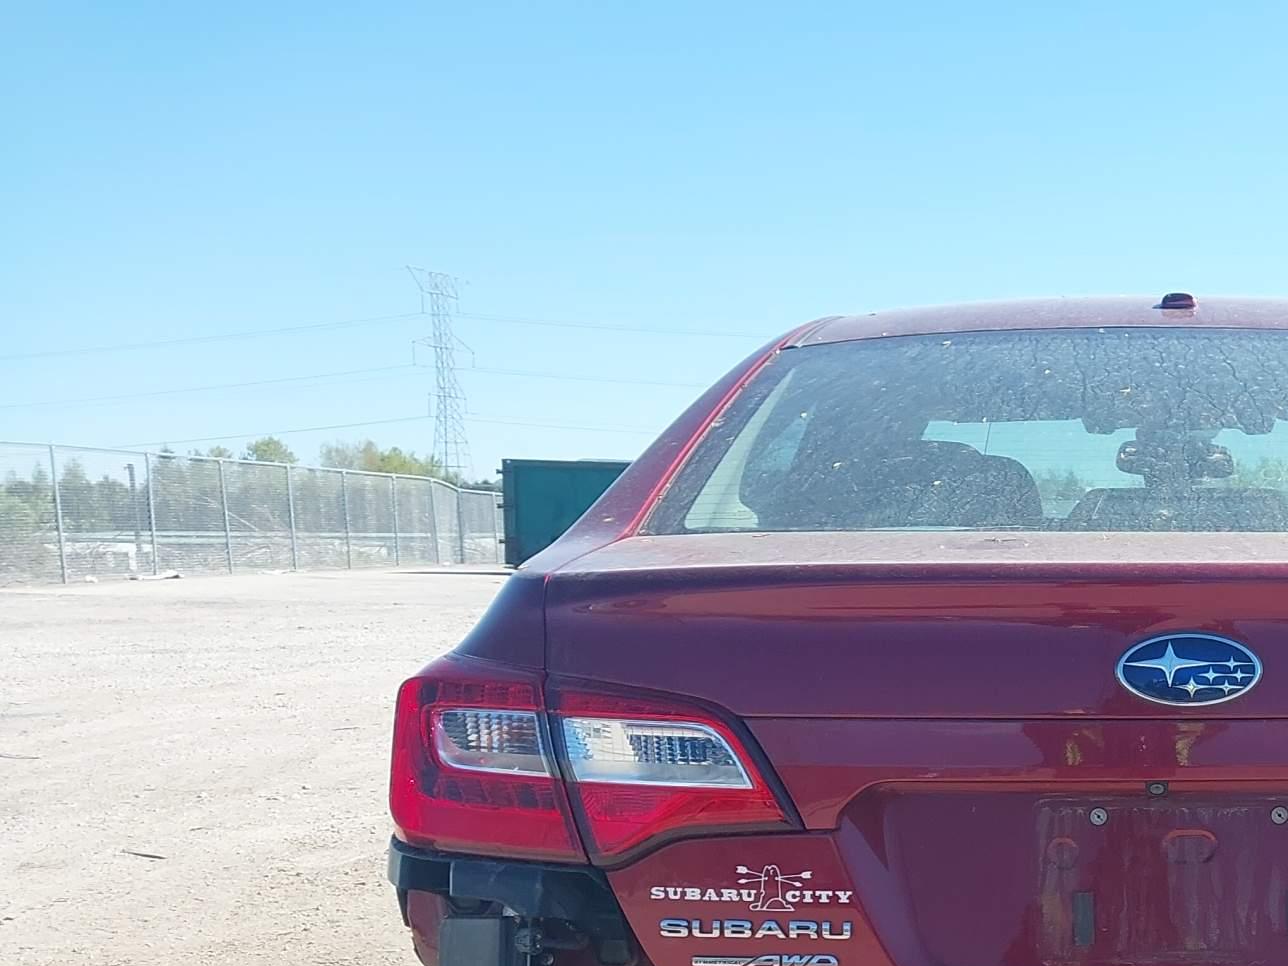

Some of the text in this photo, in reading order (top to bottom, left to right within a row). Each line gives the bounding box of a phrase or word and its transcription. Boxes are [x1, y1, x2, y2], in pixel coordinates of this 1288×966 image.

[650, 886, 853, 904] SUBARU CITY
[659, 919, 852, 940] SUBARU
